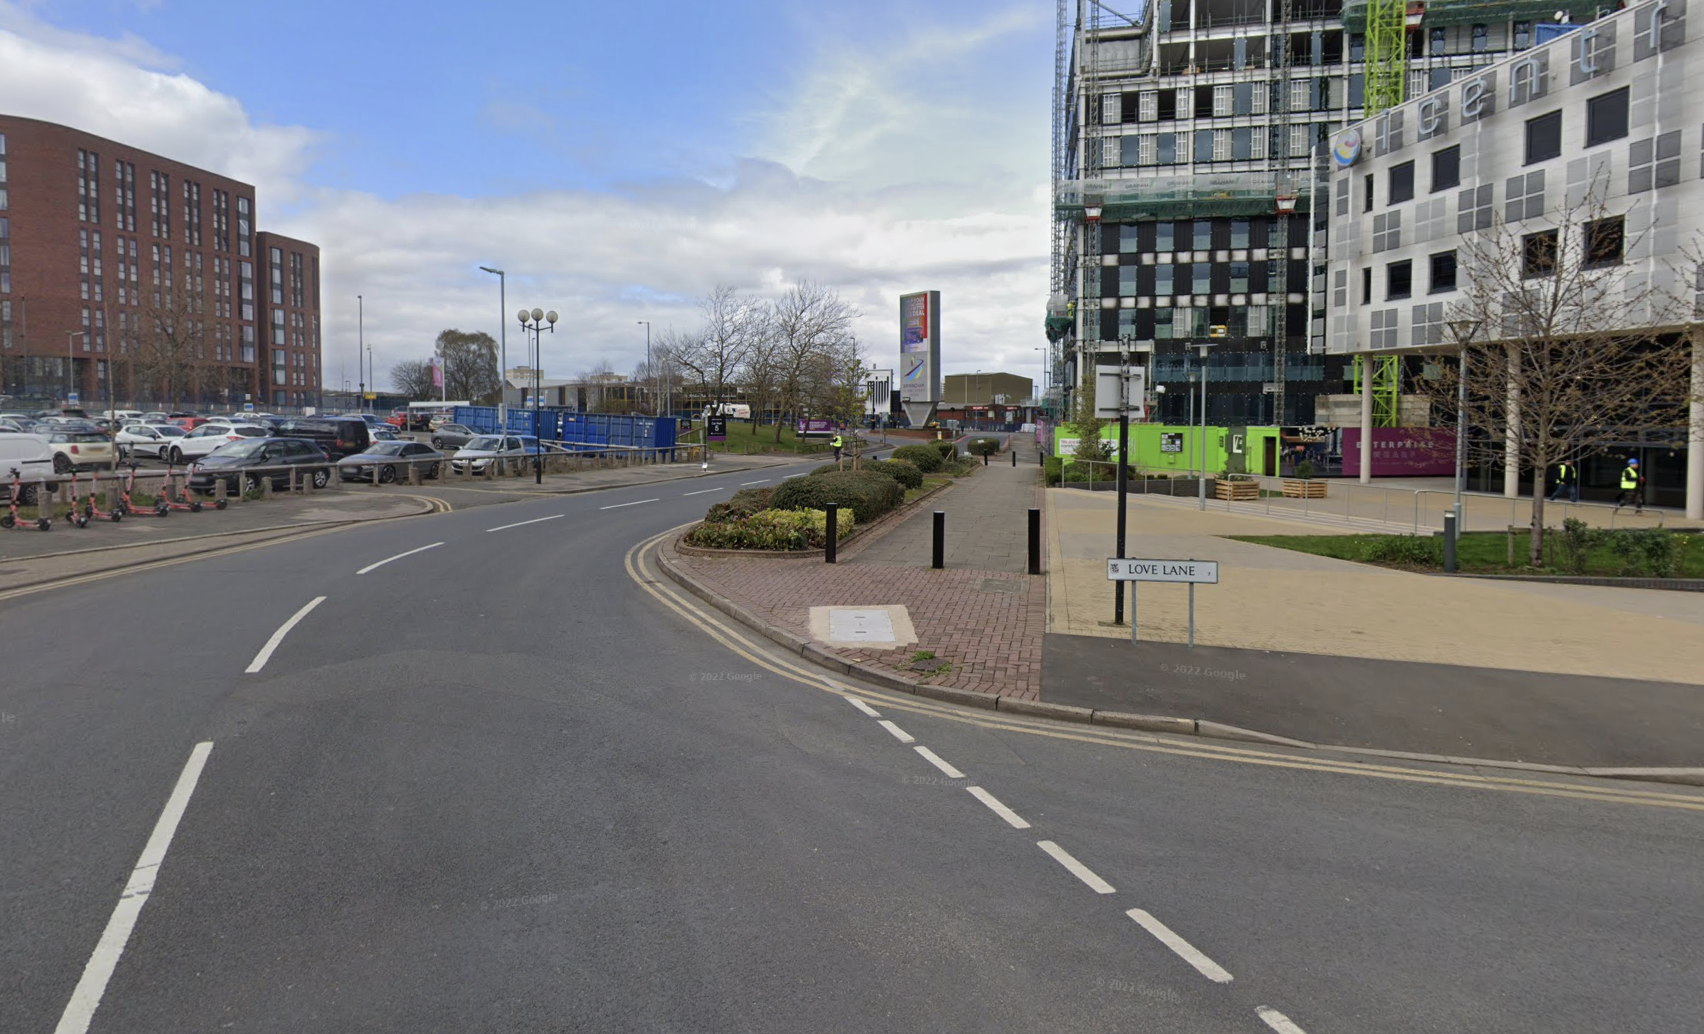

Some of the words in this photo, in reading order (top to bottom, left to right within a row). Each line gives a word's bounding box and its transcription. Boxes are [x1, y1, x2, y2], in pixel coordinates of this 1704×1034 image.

[1356, 441, 1434, 449] ETERPRISE
[1128, 563, 1158, 575] LOVE
[1162, 564, 1196, 577] LANE
